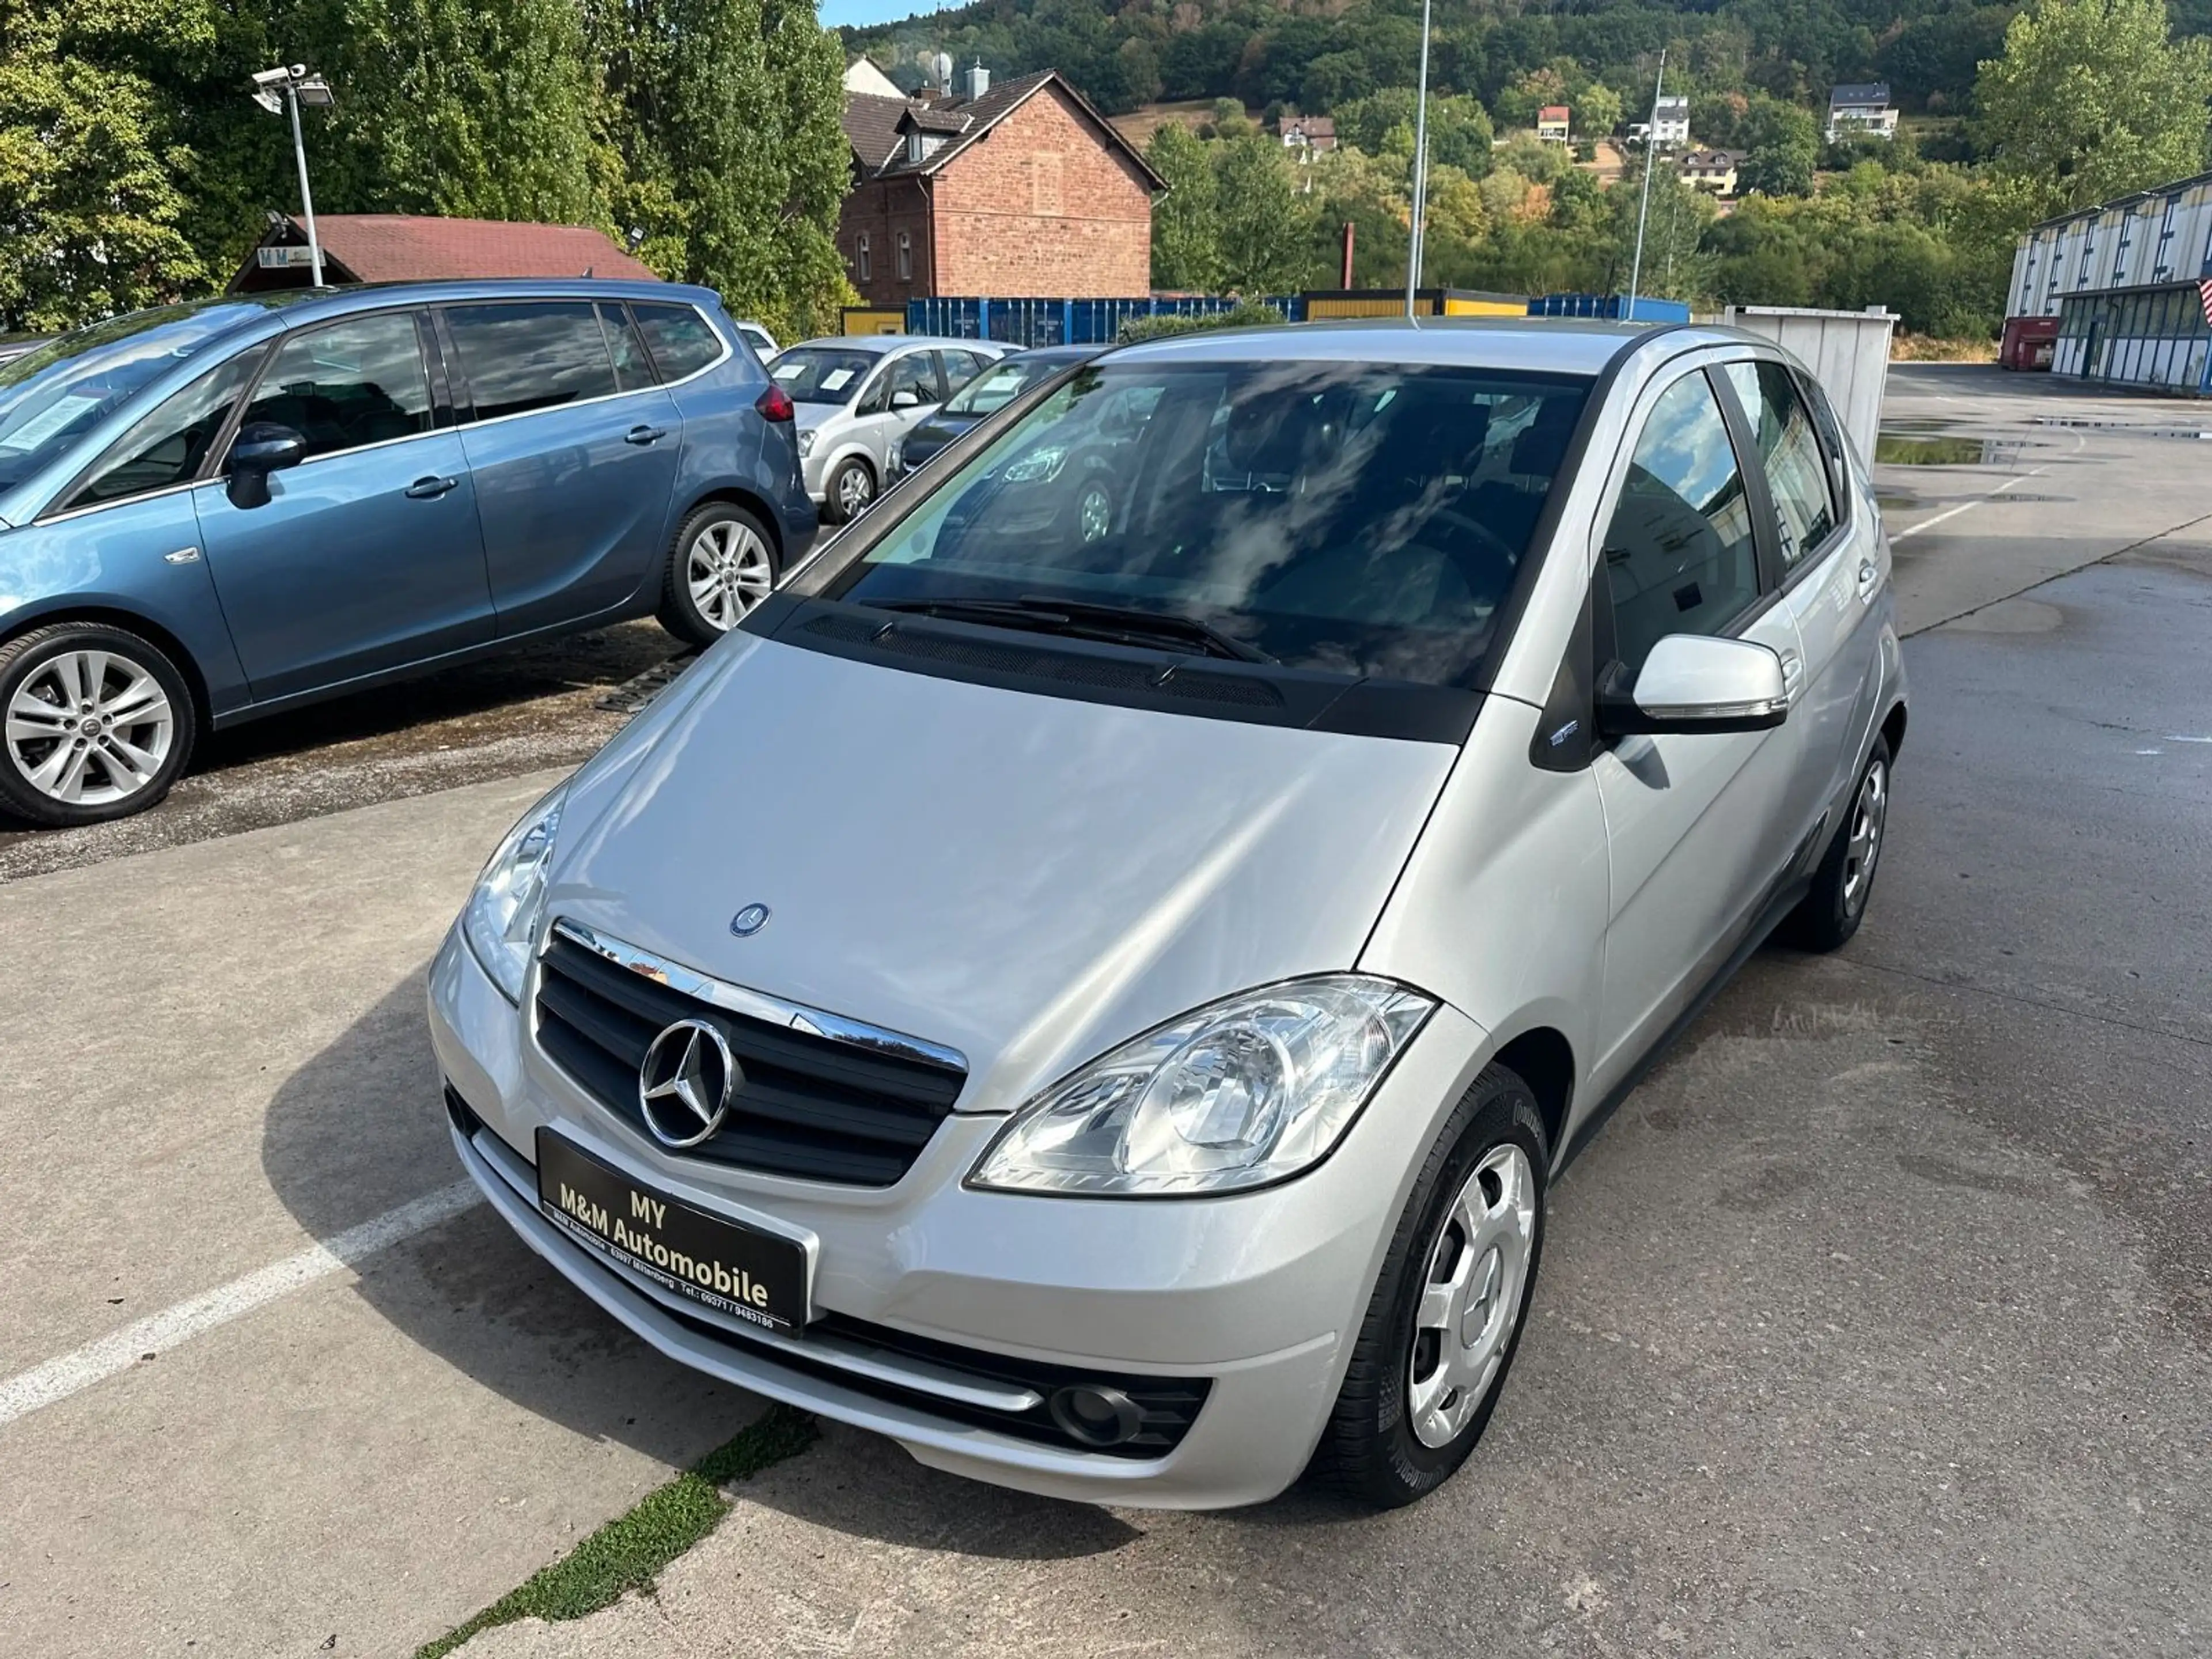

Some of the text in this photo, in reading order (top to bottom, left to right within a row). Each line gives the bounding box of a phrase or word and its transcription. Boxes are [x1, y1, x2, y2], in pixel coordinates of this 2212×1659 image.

[560, 1183, 768, 1308] M&M Automobile
[631, 1190, 666, 1230] MY
